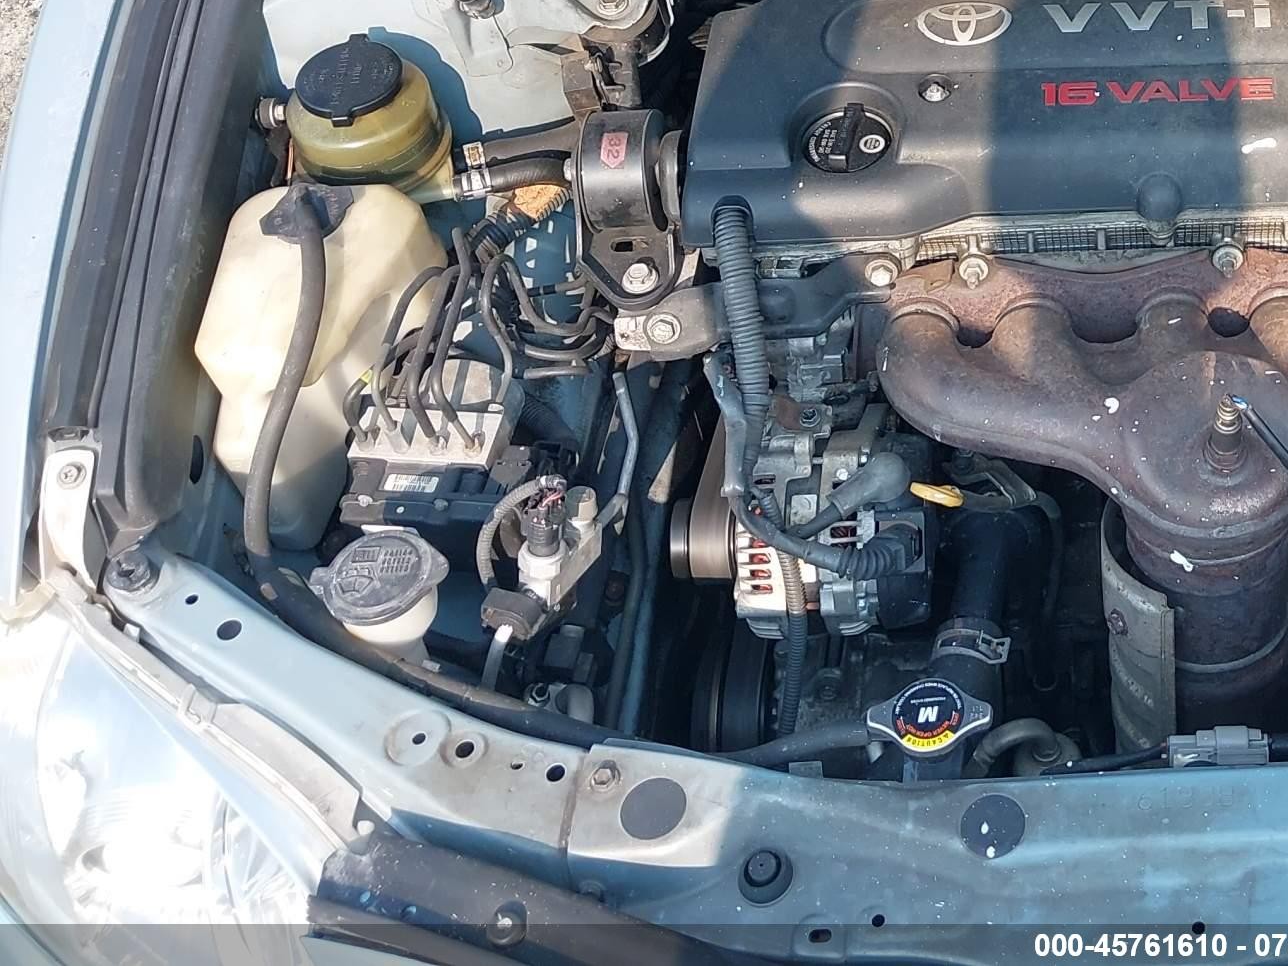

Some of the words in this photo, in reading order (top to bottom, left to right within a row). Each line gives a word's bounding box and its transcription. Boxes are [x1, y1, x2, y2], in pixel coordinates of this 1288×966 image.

[1041, 81, 1097, 106] 16
[1107, 76, 1276, 104] VALVE
[608, 137, 621, 160] 32
[917, 705, 939, 724] M
[906, 736, 943, 747] CAUTION
